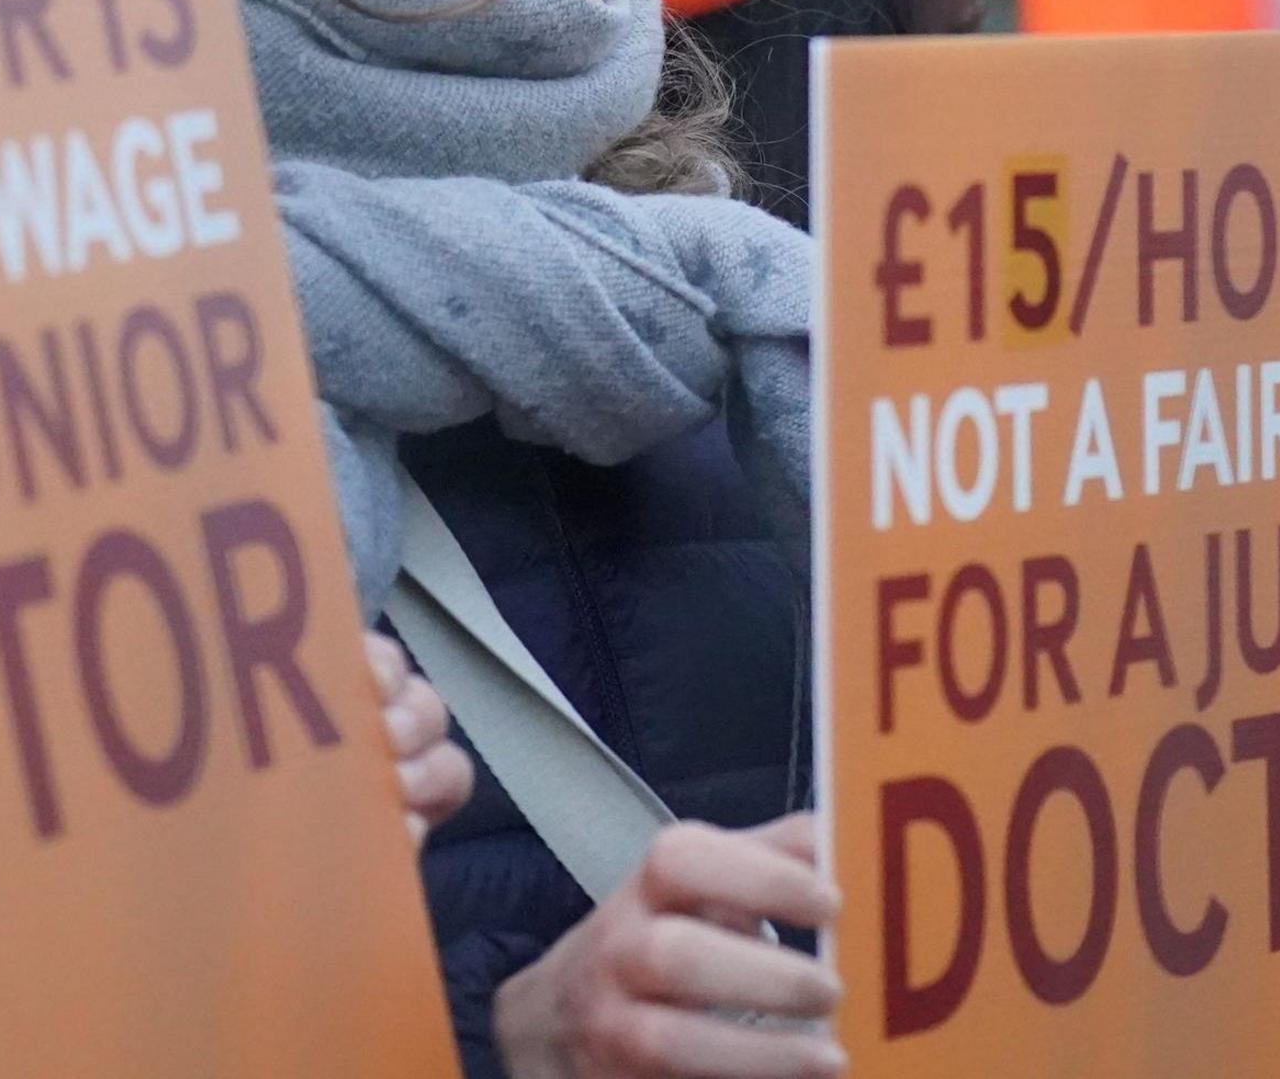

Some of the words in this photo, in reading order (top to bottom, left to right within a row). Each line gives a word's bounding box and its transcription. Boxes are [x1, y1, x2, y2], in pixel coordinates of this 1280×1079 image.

[870, 381, 1048, 531] NOT
[1063, 377, 1124, 506] A
[875, 554, 1081, 735] FOR
[1109, 542, 1179, 699] A
